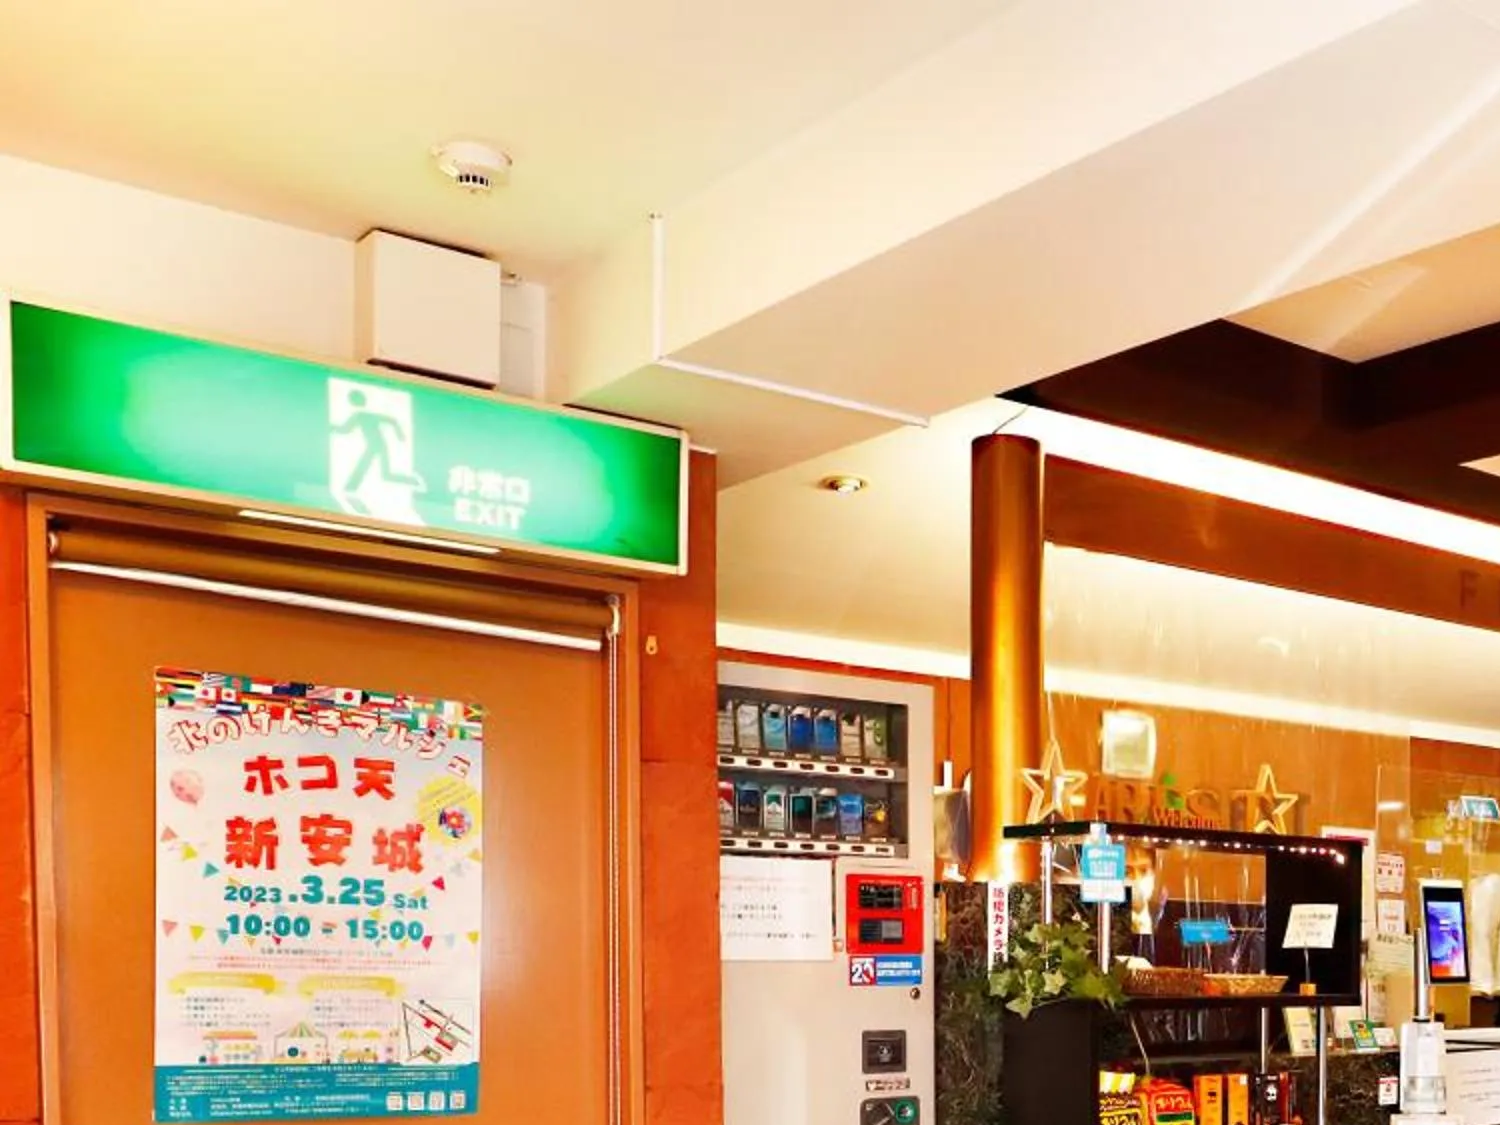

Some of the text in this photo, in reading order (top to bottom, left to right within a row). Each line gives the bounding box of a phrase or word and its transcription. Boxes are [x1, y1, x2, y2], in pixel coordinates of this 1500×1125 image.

[454, 497, 527, 530] EXIT
[244, 755, 396, 801] ホコ天
[224, 814, 425, 875] 新安城
[392, 893, 429, 911] Sat
[225, 914, 311, 937] 10:00
[345, 918, 425, 942] 15:00
